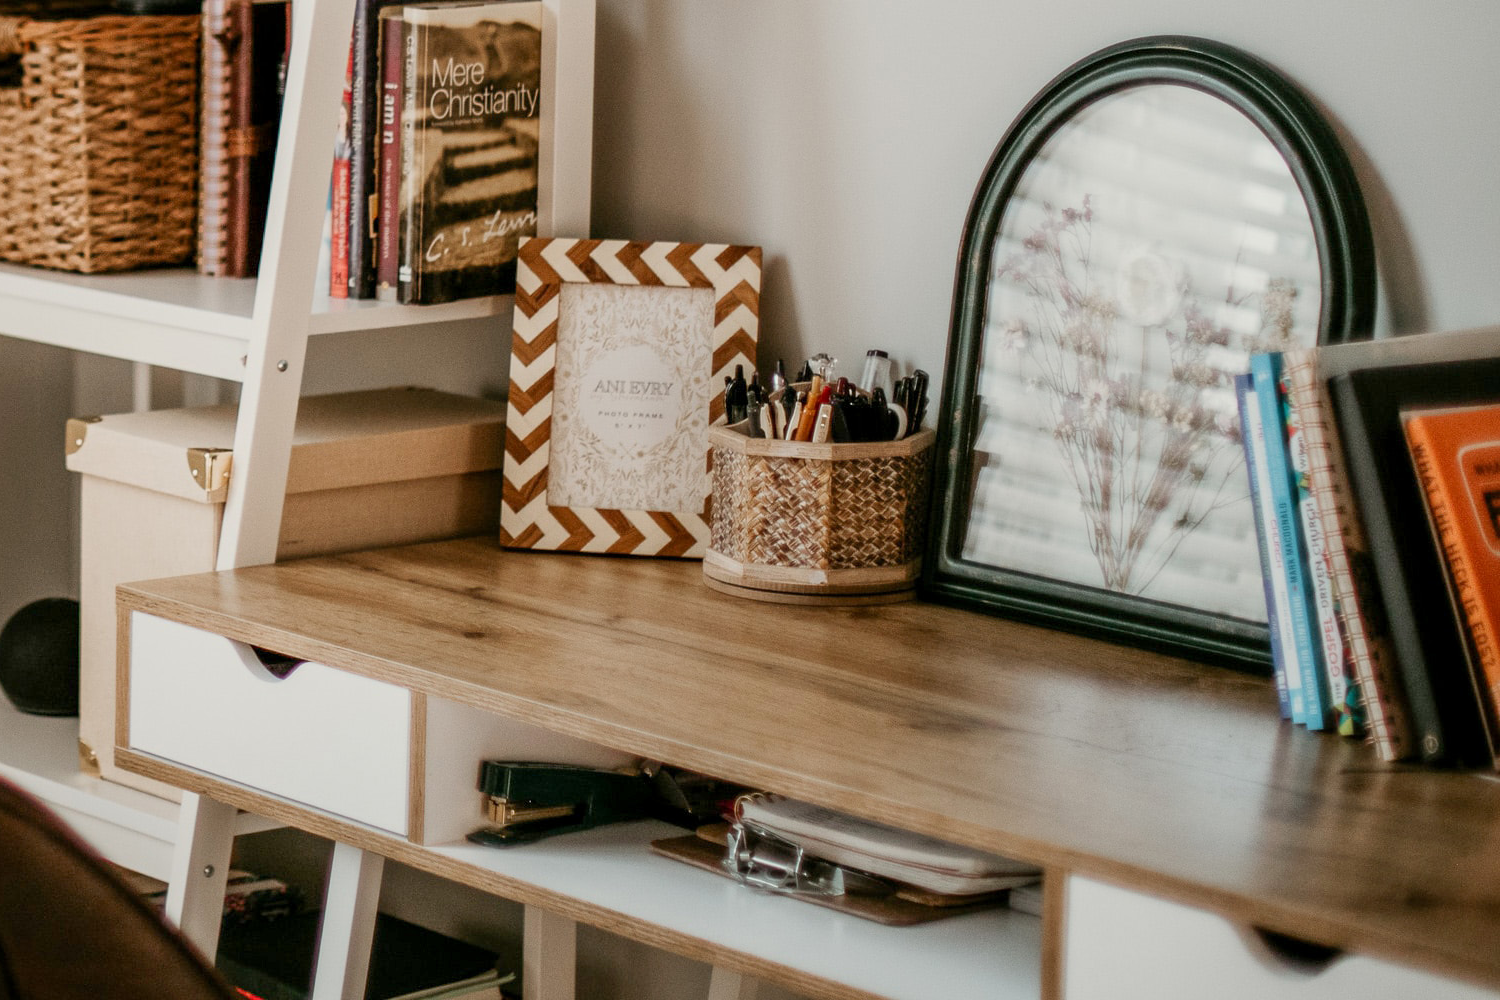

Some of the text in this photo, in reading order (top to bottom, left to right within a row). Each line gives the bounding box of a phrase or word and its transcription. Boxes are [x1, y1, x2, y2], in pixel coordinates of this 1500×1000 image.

[432, 57, 485, 89] Mere
[383, 93, 395, 124] am
[430, 82, 539, 120] Christianity
[383, 130, 394, 144] n
[593, 380, 626, 394] ANI
[633, 412, 664, 420] FRAME
[1278, 502, 1295, 556] MACDONALD
[1305, 502, 1321, 556] CHURCH
[1412, 444, 1440, 494] WHAT
[1431, 501, 1454, 533] THE
[1444, 543, 1472, 592] HECK
[1286, 558, 1299, 583] MARK
[1292, 596, 1308, 647] SOMETHING
[1303, 669, 1316, 700] KNOWN
